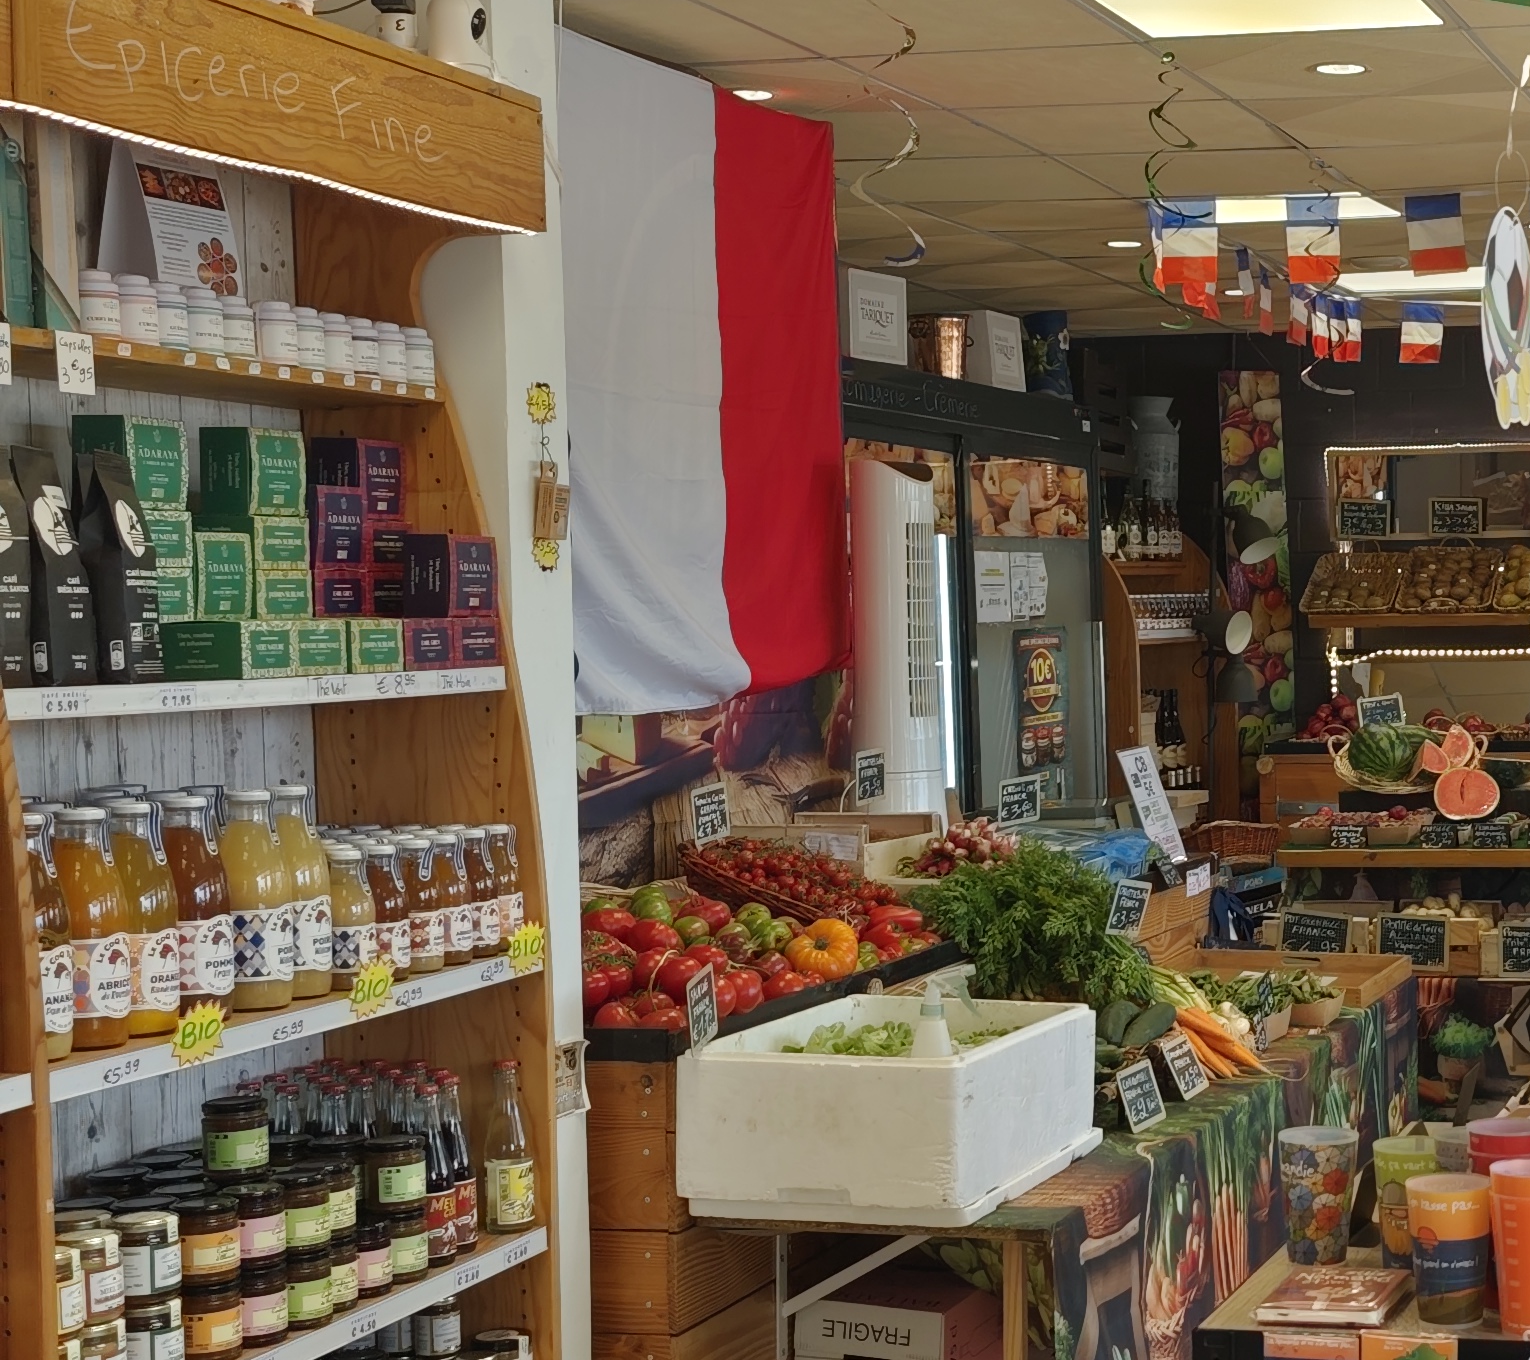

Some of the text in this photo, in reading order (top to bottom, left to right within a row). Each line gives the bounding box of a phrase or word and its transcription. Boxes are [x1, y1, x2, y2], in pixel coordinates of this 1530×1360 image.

[331, 76, 450, 163] Fine
[860, 307, 894, 328] TARIQUET
[59, 339, 92, 355] Capsules
[1030, 656, 1052, 684] 10€
[57, 700, 79, 712] 5.99
[103, 1058, 140, 1084] €5,99
[822, 1318, 911, 1348] FRAGILE
